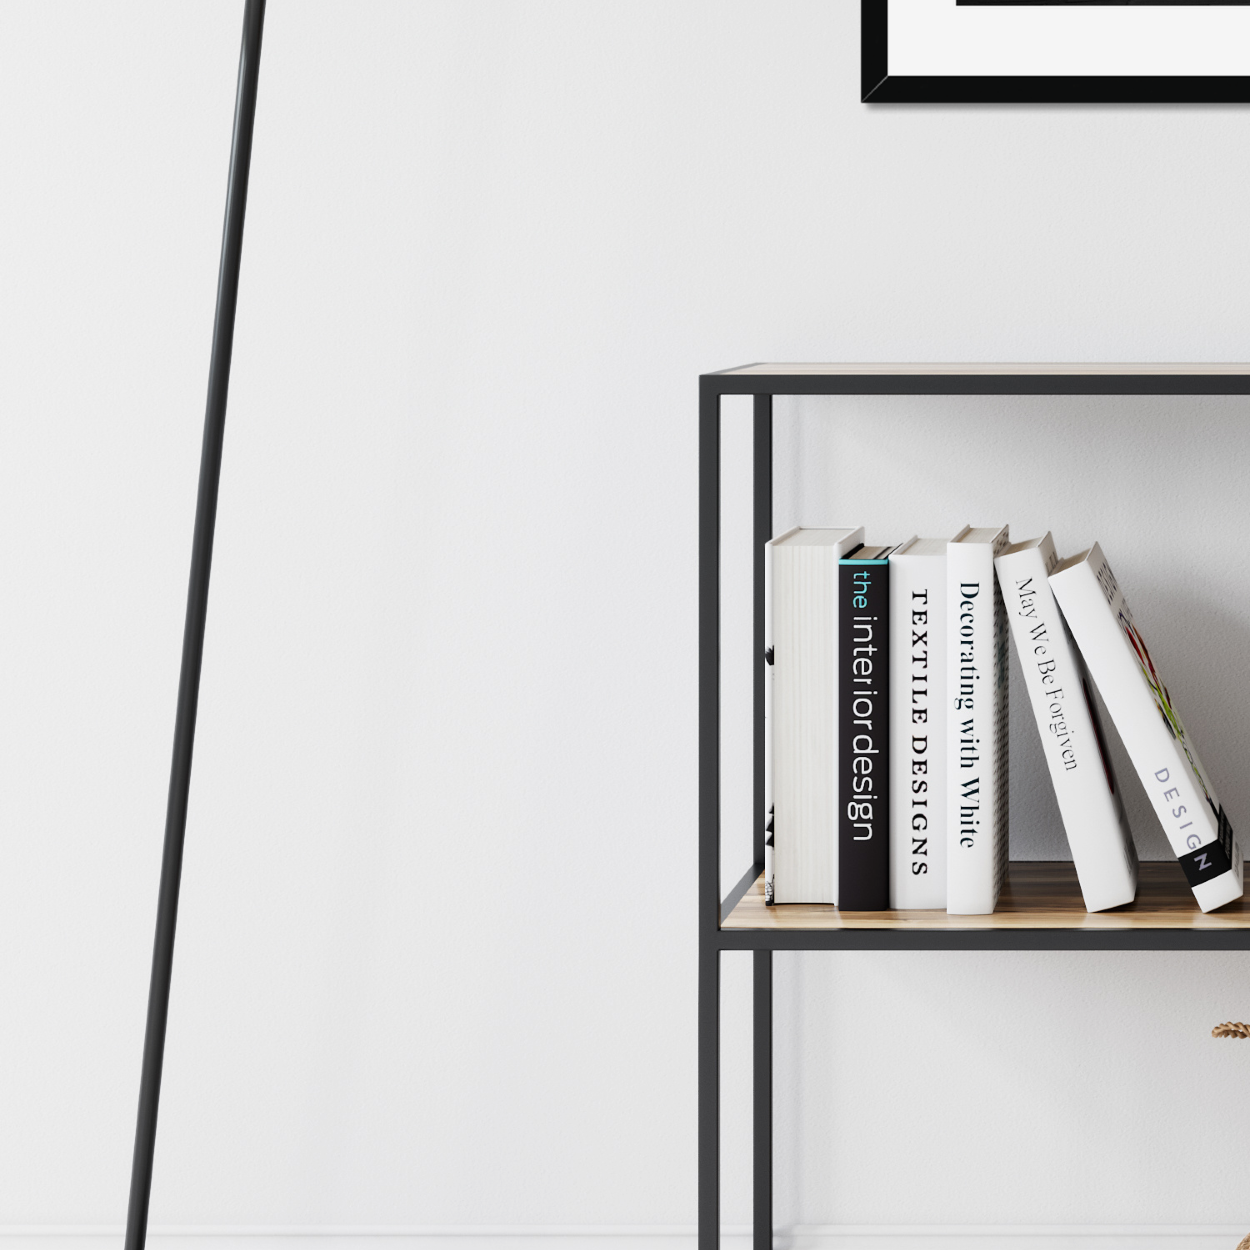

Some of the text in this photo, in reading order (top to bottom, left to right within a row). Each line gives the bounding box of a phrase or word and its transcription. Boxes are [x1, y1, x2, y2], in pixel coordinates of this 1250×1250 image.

[852, 570, 872, 609] the
[1015, 576, 1078, 771] May We Be Forgiven
[911, 588, 928, 876] TEXTILE DESIGNS
[954, 582, 981, 849] Decorating with White
[1154, 767, 1212, 871] DESIGN
